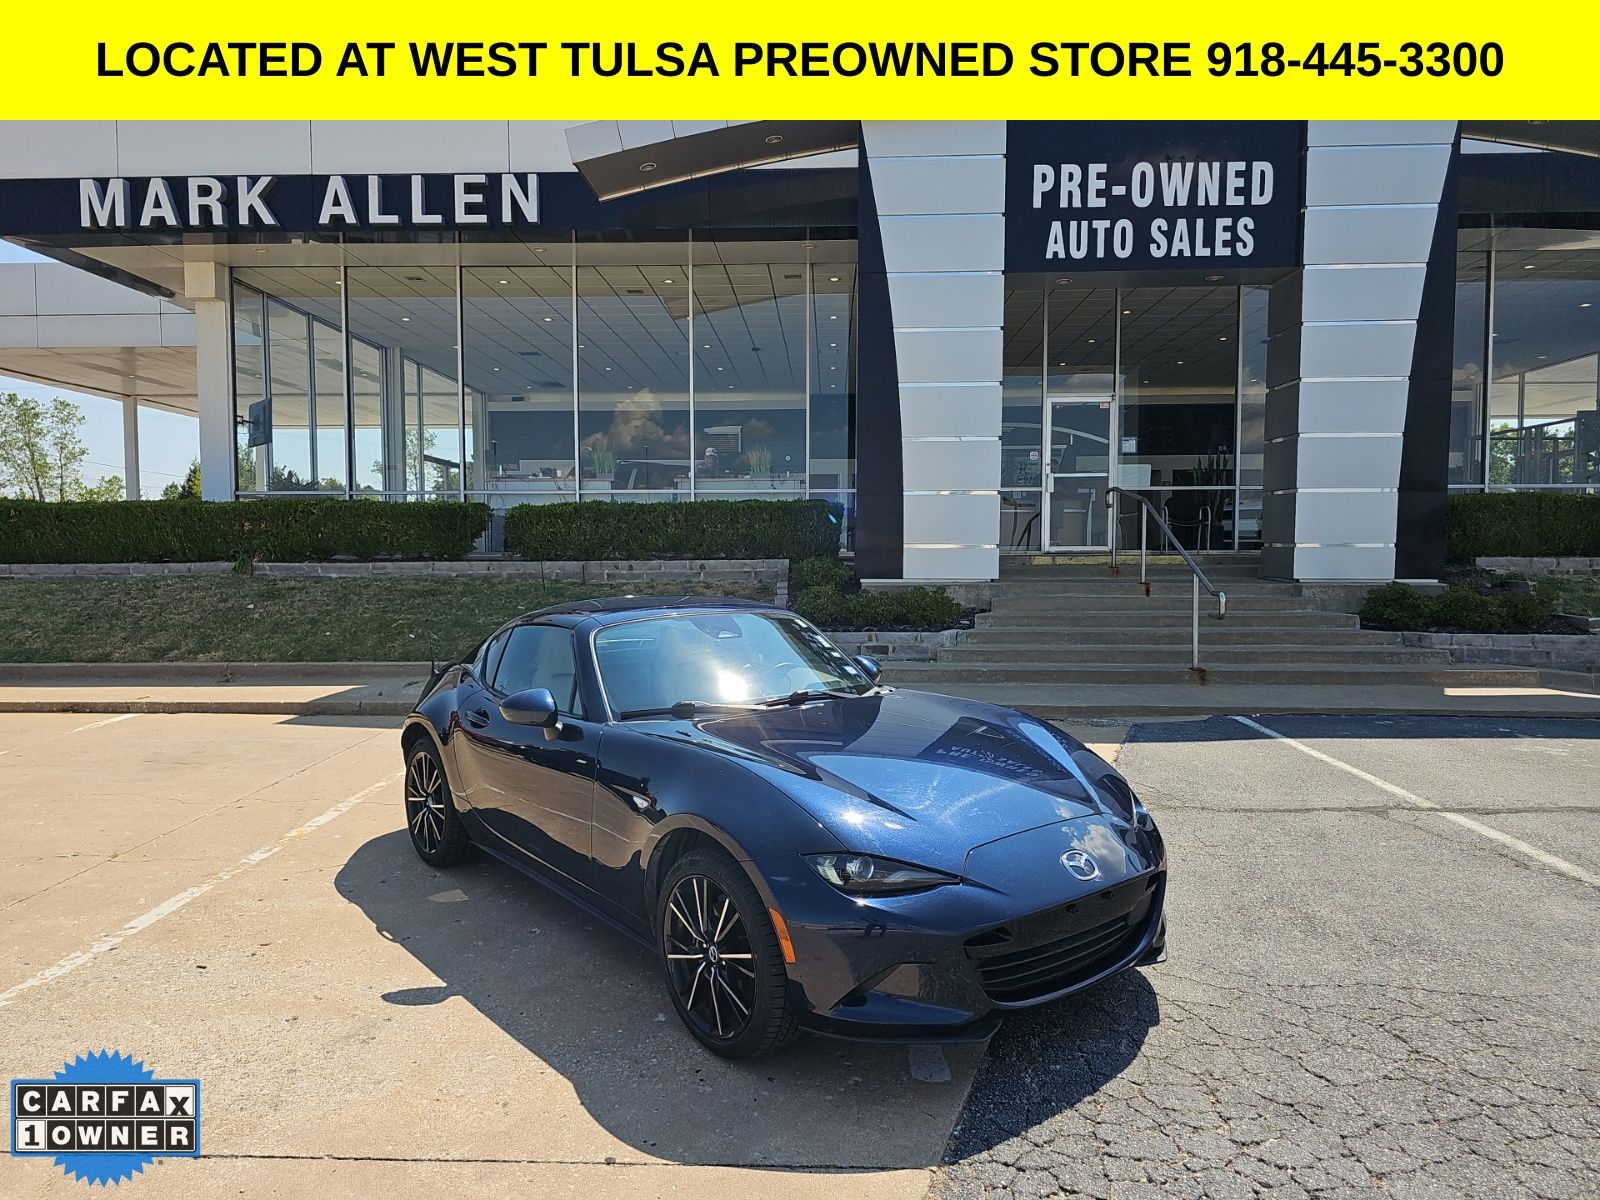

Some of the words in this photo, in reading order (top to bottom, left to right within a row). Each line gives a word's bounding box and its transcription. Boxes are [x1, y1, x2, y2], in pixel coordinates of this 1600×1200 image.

[79, 176, 279, 228] MARK
[318, 174, 540, 226] ALLEN
[1032, 161, 1274, 209] PRE-OWNED
[1045, 218, 1134, 260] AUTO
[1149, 216, 1255, 259] SALES
